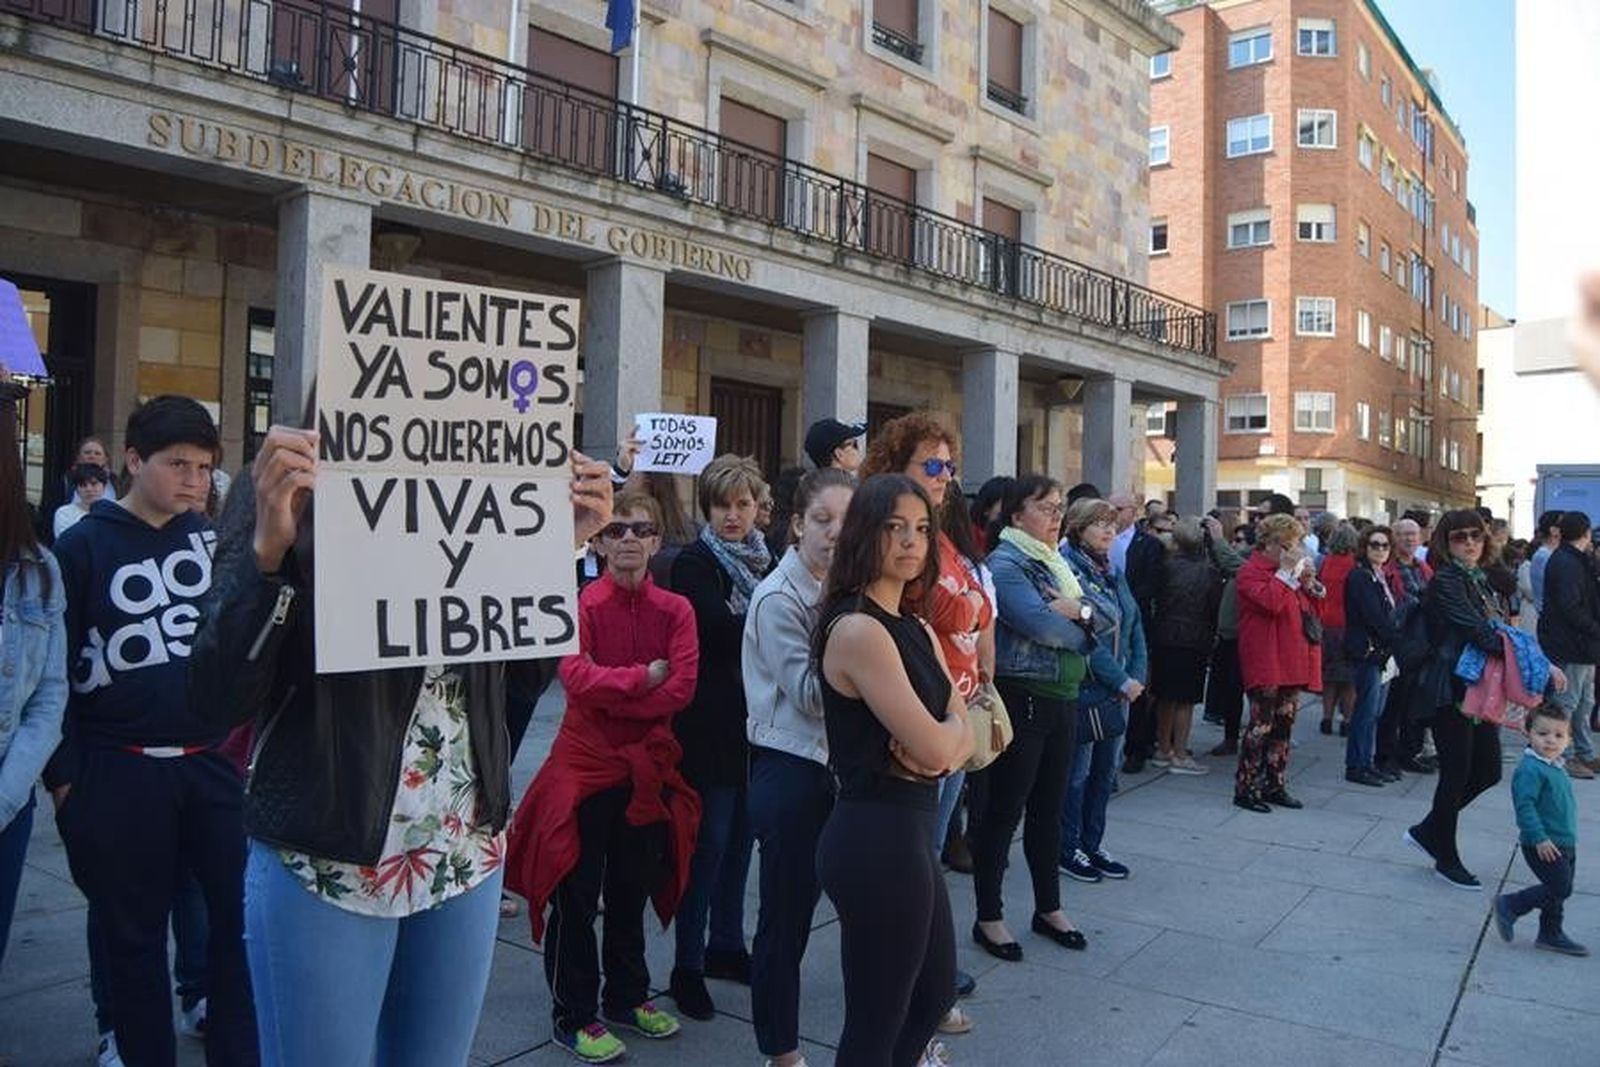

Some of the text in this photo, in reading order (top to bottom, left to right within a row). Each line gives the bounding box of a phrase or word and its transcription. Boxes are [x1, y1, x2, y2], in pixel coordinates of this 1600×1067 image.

[147, 113, 751, 282] SUBDELEGACION DEL GOBIERNO
[334, 279, 577, 351] VALIENTES
[349, 341, 413, 399] YA
[319, 408, 569, 468] NOS QUEREMOS
[650, 417, 697, 434] TODAS
[650, 434, 706, 451] SOMOS
[651, 452, 691, 466] LETY
[351, 478, 546, 537] VIVAS
[438, 539, 474, 589] Y
[376, 595, 576, 658] LIBRES
